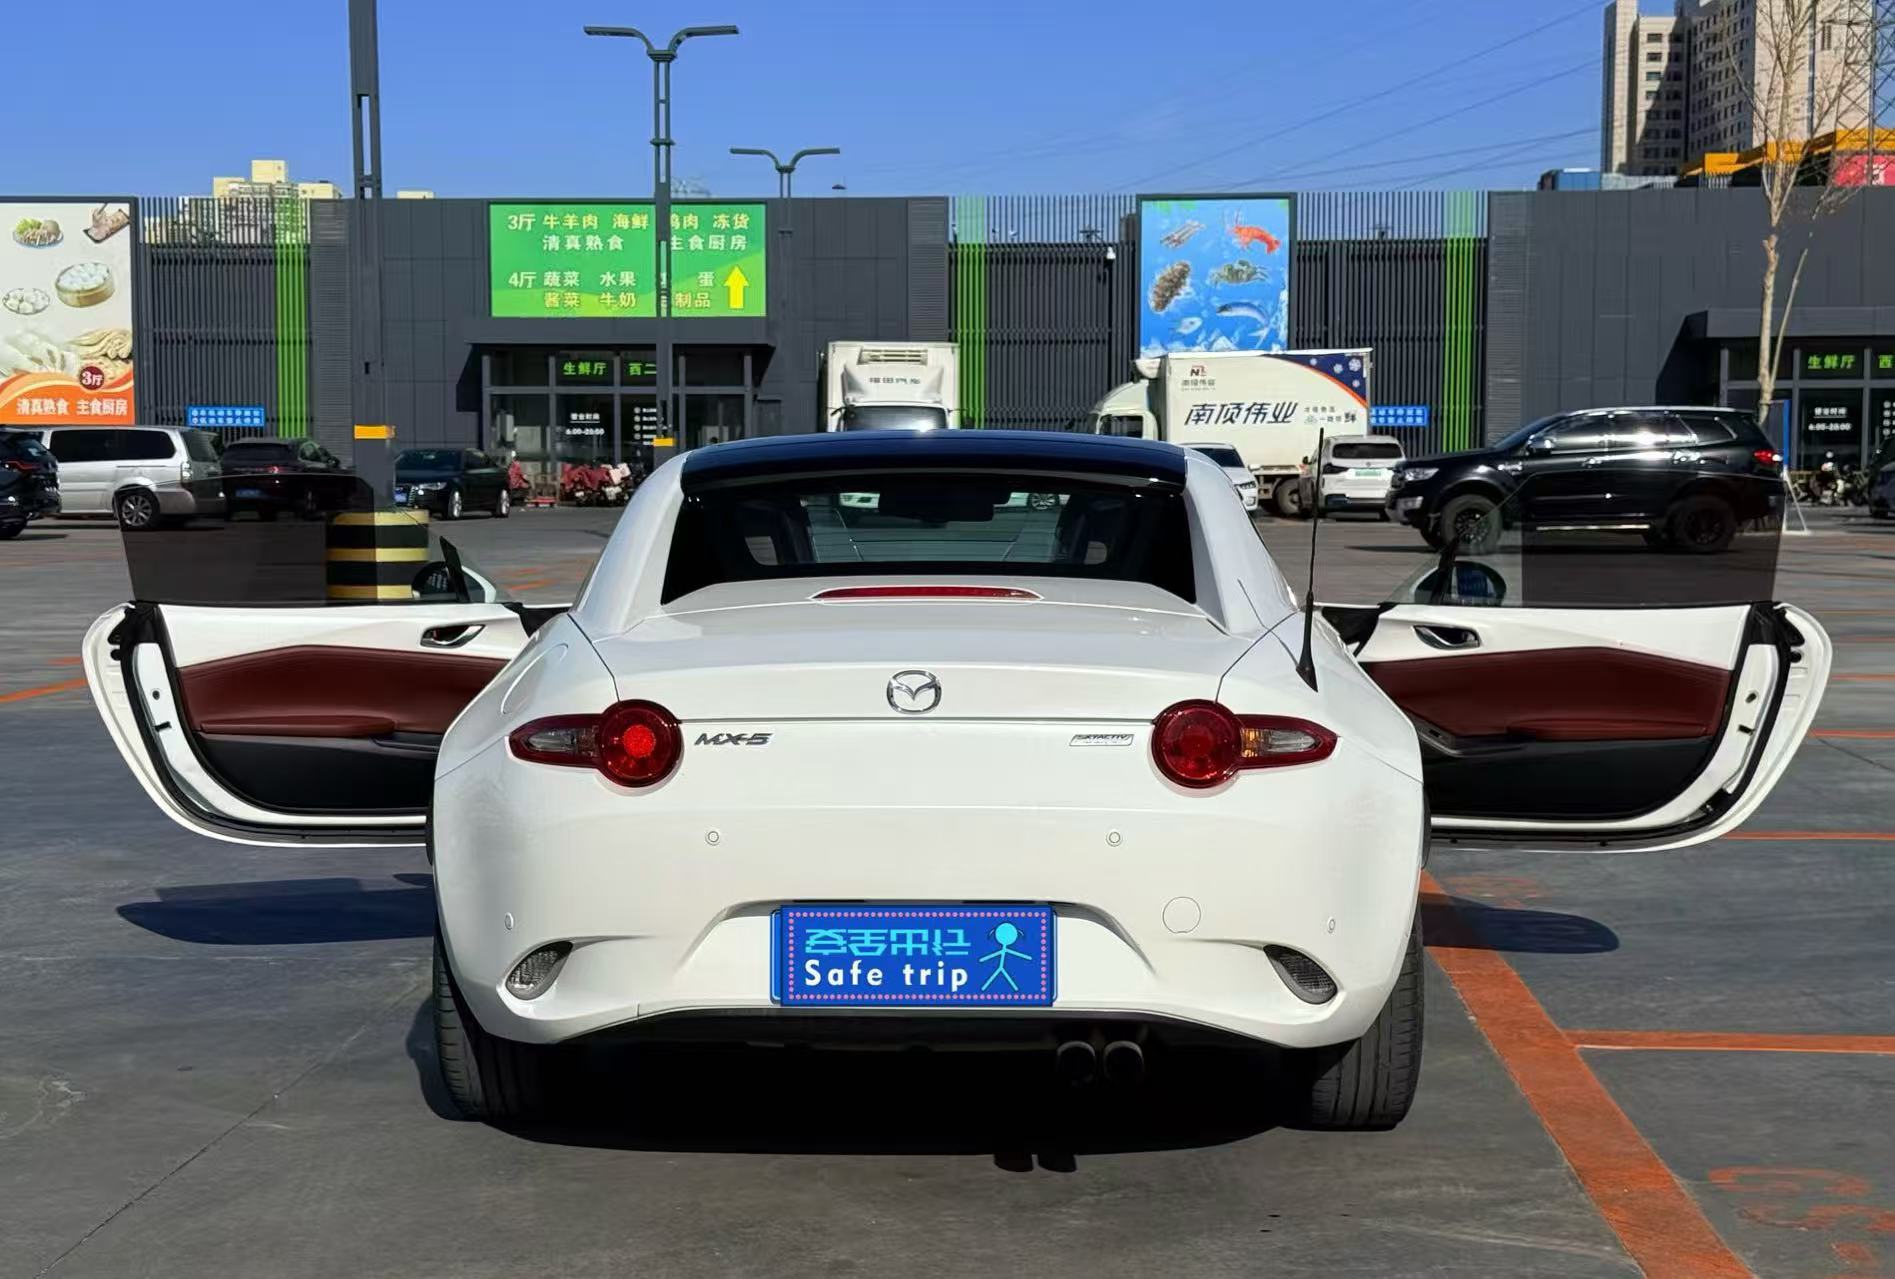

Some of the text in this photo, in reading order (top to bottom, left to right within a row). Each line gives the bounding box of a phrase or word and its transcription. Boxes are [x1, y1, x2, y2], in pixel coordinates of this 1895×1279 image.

[507, 213, 537, 232] 3厅
[542, 213, 598, 230] 牛羊肉
[612, 213, 649, 230] 海鲜
[713, 213, 750, 230] 冻货
[542, 234, 748, 251] 清真熟食 主食厨房
[508, 271, 537, 288] 4厅
[543, 271, 580, 287] 蔬菜
[600, 271, 636, 287] 水果
[599, 292, 636, 308] 牛奶
[563, 362, 607, 375] 生鲜厅
[81, 370, 102, 386] 3厅
[16, 398, 128, 416] 清真熟食 主食厨房
[1184, 401, 1299, 425] 南顶伟业
[693, 732, 774, 746] MX-5
[804, 958, 969, 992] Safe trip
